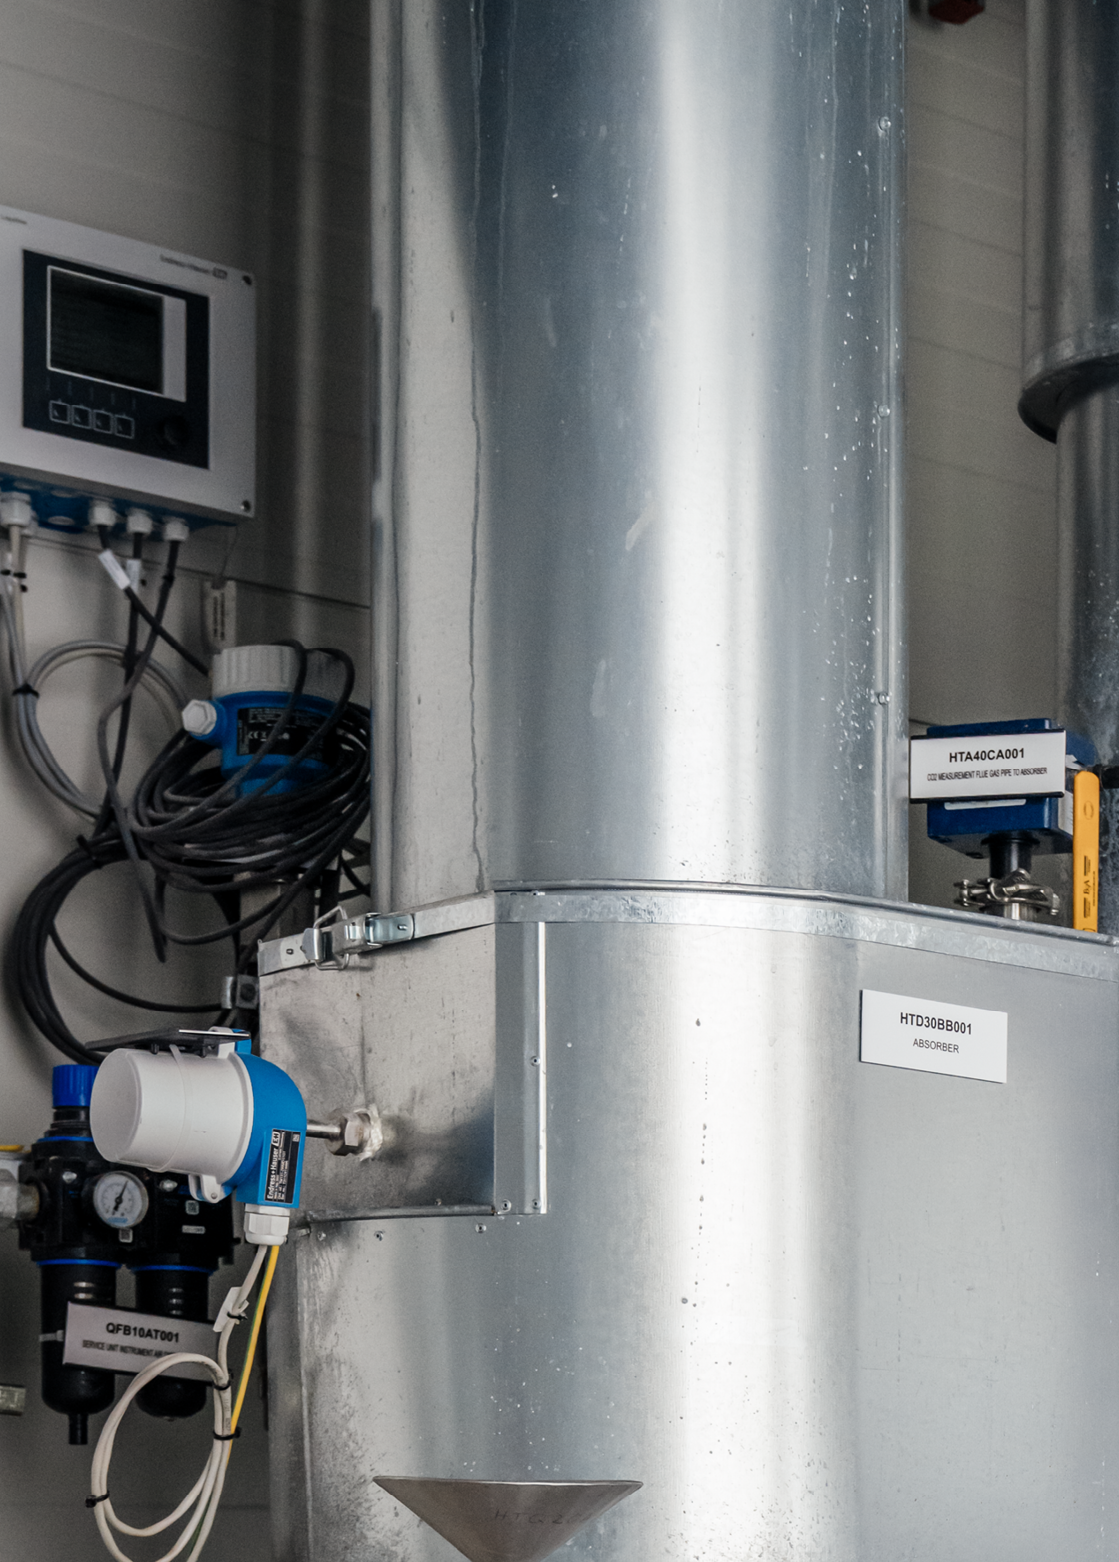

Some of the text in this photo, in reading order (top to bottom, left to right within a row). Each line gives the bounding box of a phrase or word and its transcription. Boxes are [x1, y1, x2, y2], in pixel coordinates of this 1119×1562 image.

[949, 748, 1025, 763] HTA40CA001
[938, 770, 975, 781] MEASUREMENT
[976, 769, 988, 779] FLUE
[989, 769, 1000, 778] GAS
[1001, 768, 1012, 777] PIPE
[1013, 768, 1020, 776] TO
[1020, 766, 1048, 776] ABSORBER
[900, 1012, 972, 1035] HTD30BB001
[913, 1038, 960, 1054] ABSORBER
[106, 1322, 180, 1343] QFB10AT001
[82, 1339, 105, 1351] SERVICE
